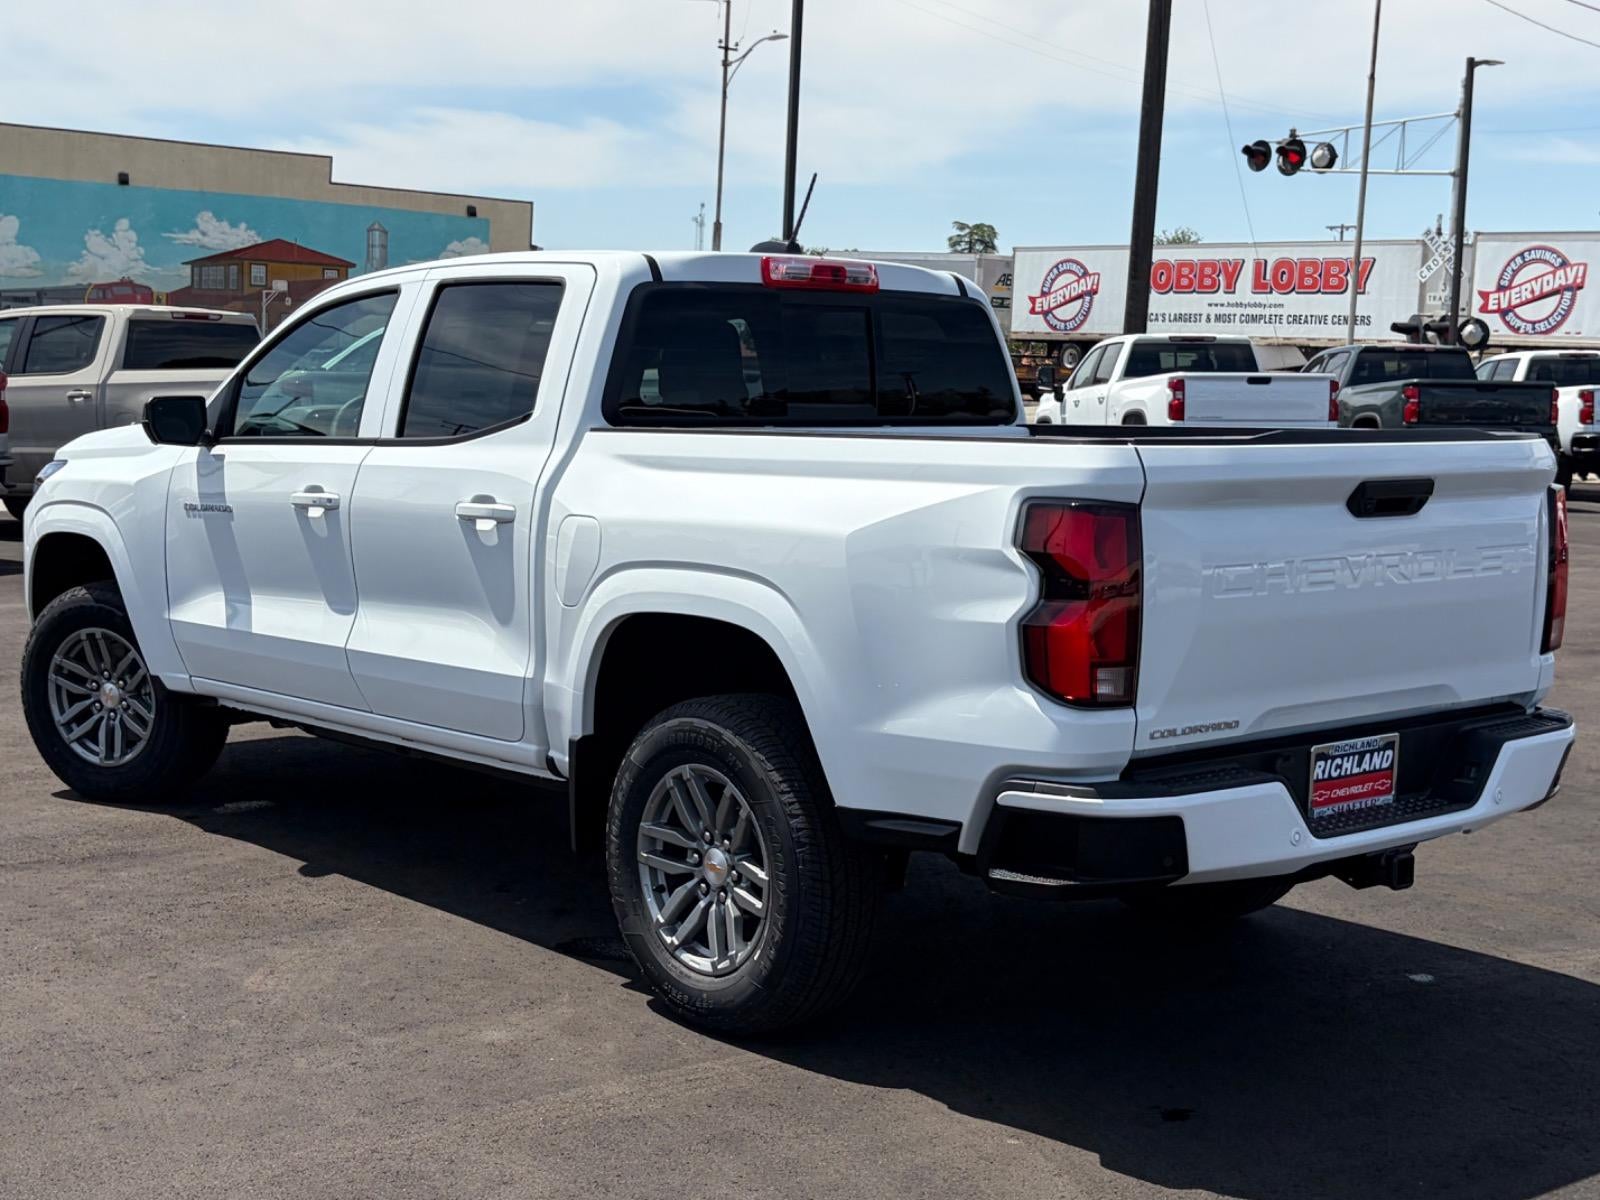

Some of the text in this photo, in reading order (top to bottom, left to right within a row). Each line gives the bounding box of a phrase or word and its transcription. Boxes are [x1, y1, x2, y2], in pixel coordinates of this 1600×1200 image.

[1042, 262, 1084, 293] SUPER SAVINGS
[1150, 257, 1376, 295] OBBY LOBBY
[1499, 249, 1563, 288] SUPER SAVINGS
[1034, 274, 1099, 313] EVERYDAY!
[1487, 264, 1585, 311] EVERYDAY!
[1046, 295, 1091, 331] SUPER SELECTION
[1148, 312, 1372, 327] CA'S LARGEST & MOST COMPLETE CREATIVE CENERS
[1207, 301, 1284, 310] www.hobbylobby.com
[1505, 291, 1572, 334] SUPER SELECTION
[1148, 719, 1240, 741] COLORADO
[1334, 738, 1379, 753] RICHLAND
[1312, 748, 1394, 780] RICHLAND
[1330, 782, 1374, 798] CHEVROLET
